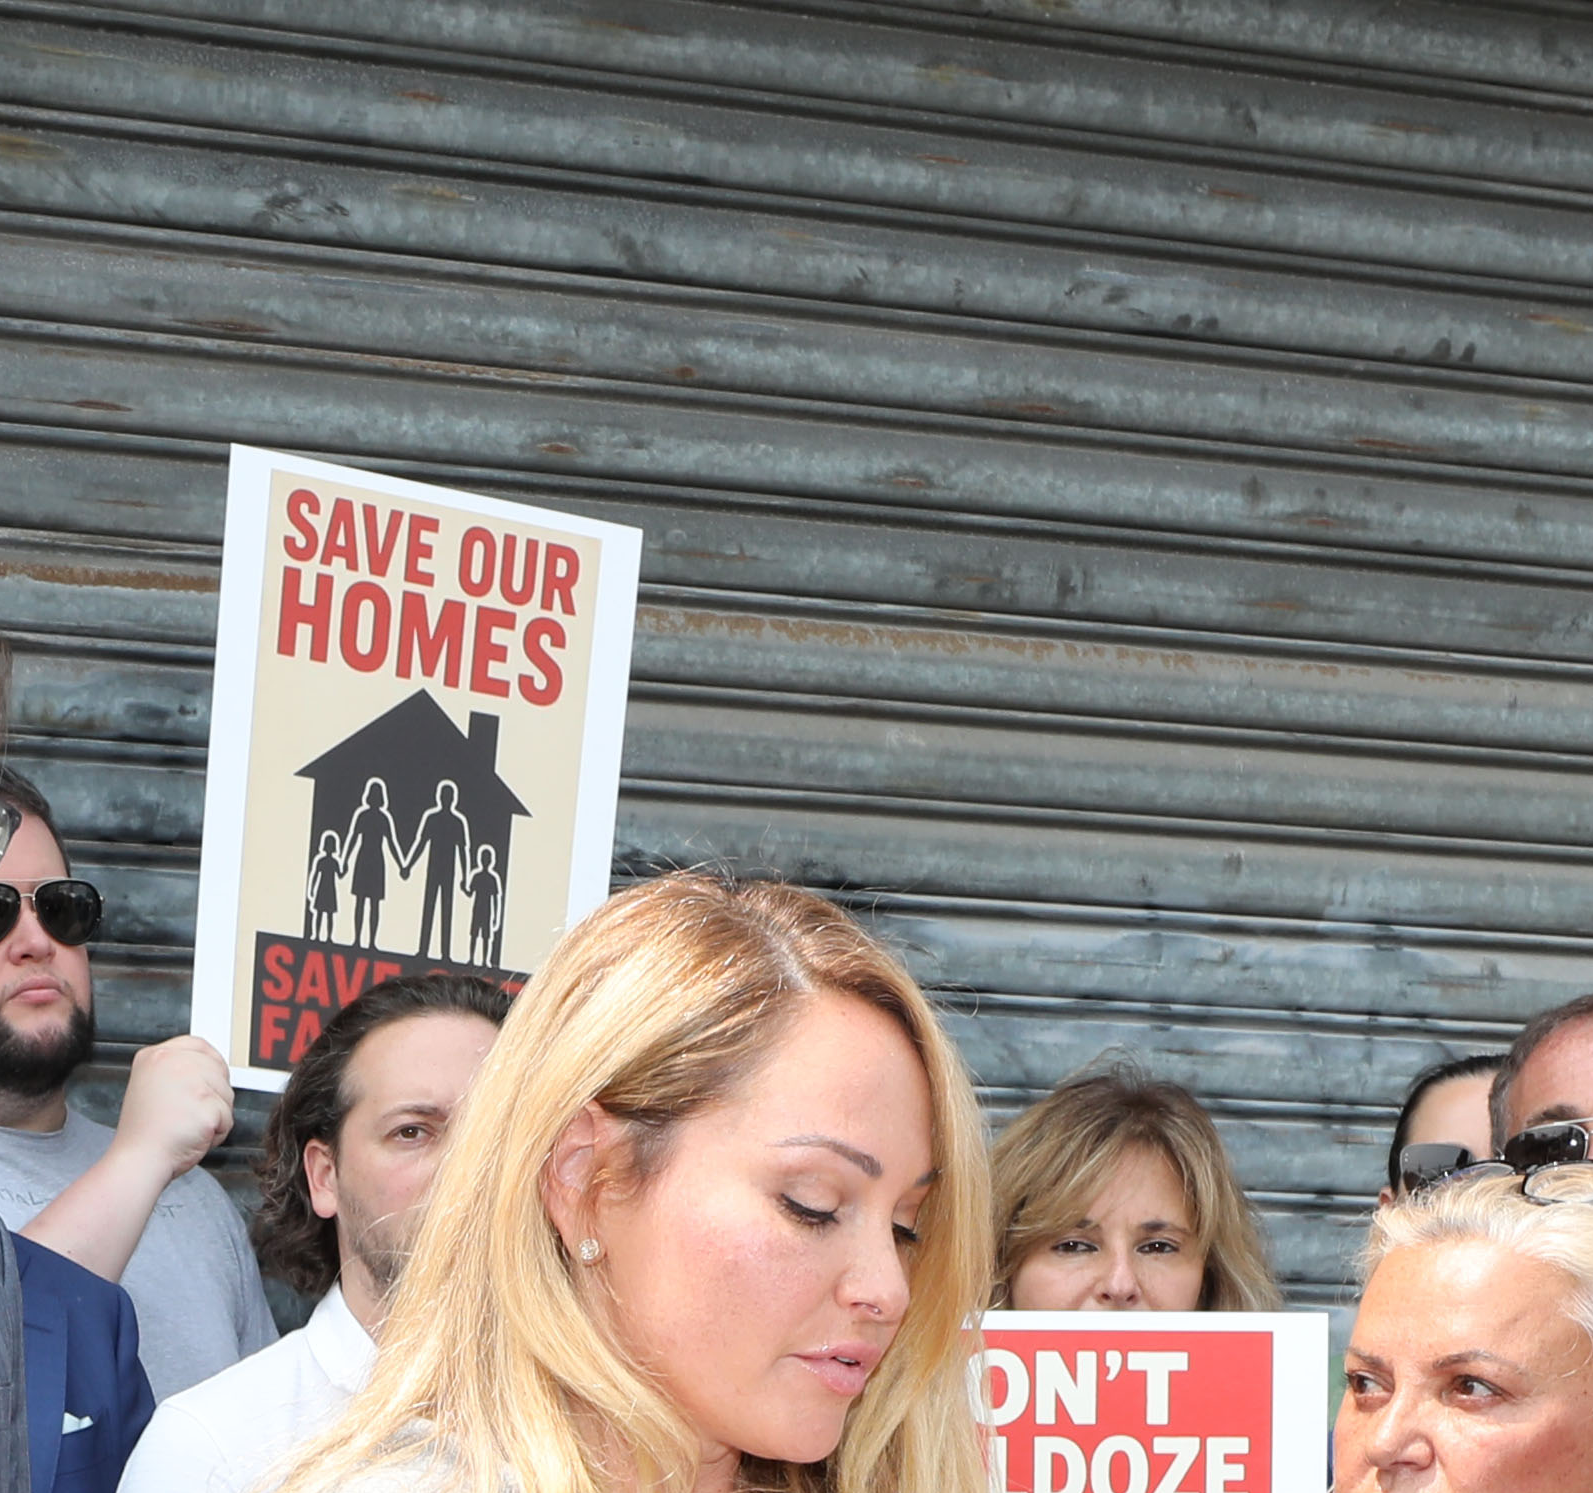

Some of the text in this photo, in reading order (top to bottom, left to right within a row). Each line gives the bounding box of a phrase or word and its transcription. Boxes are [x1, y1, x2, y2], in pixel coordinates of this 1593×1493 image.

[283, 488, 581, 618] SAVE OUR
[277, 566, 567, 709] HOMES
